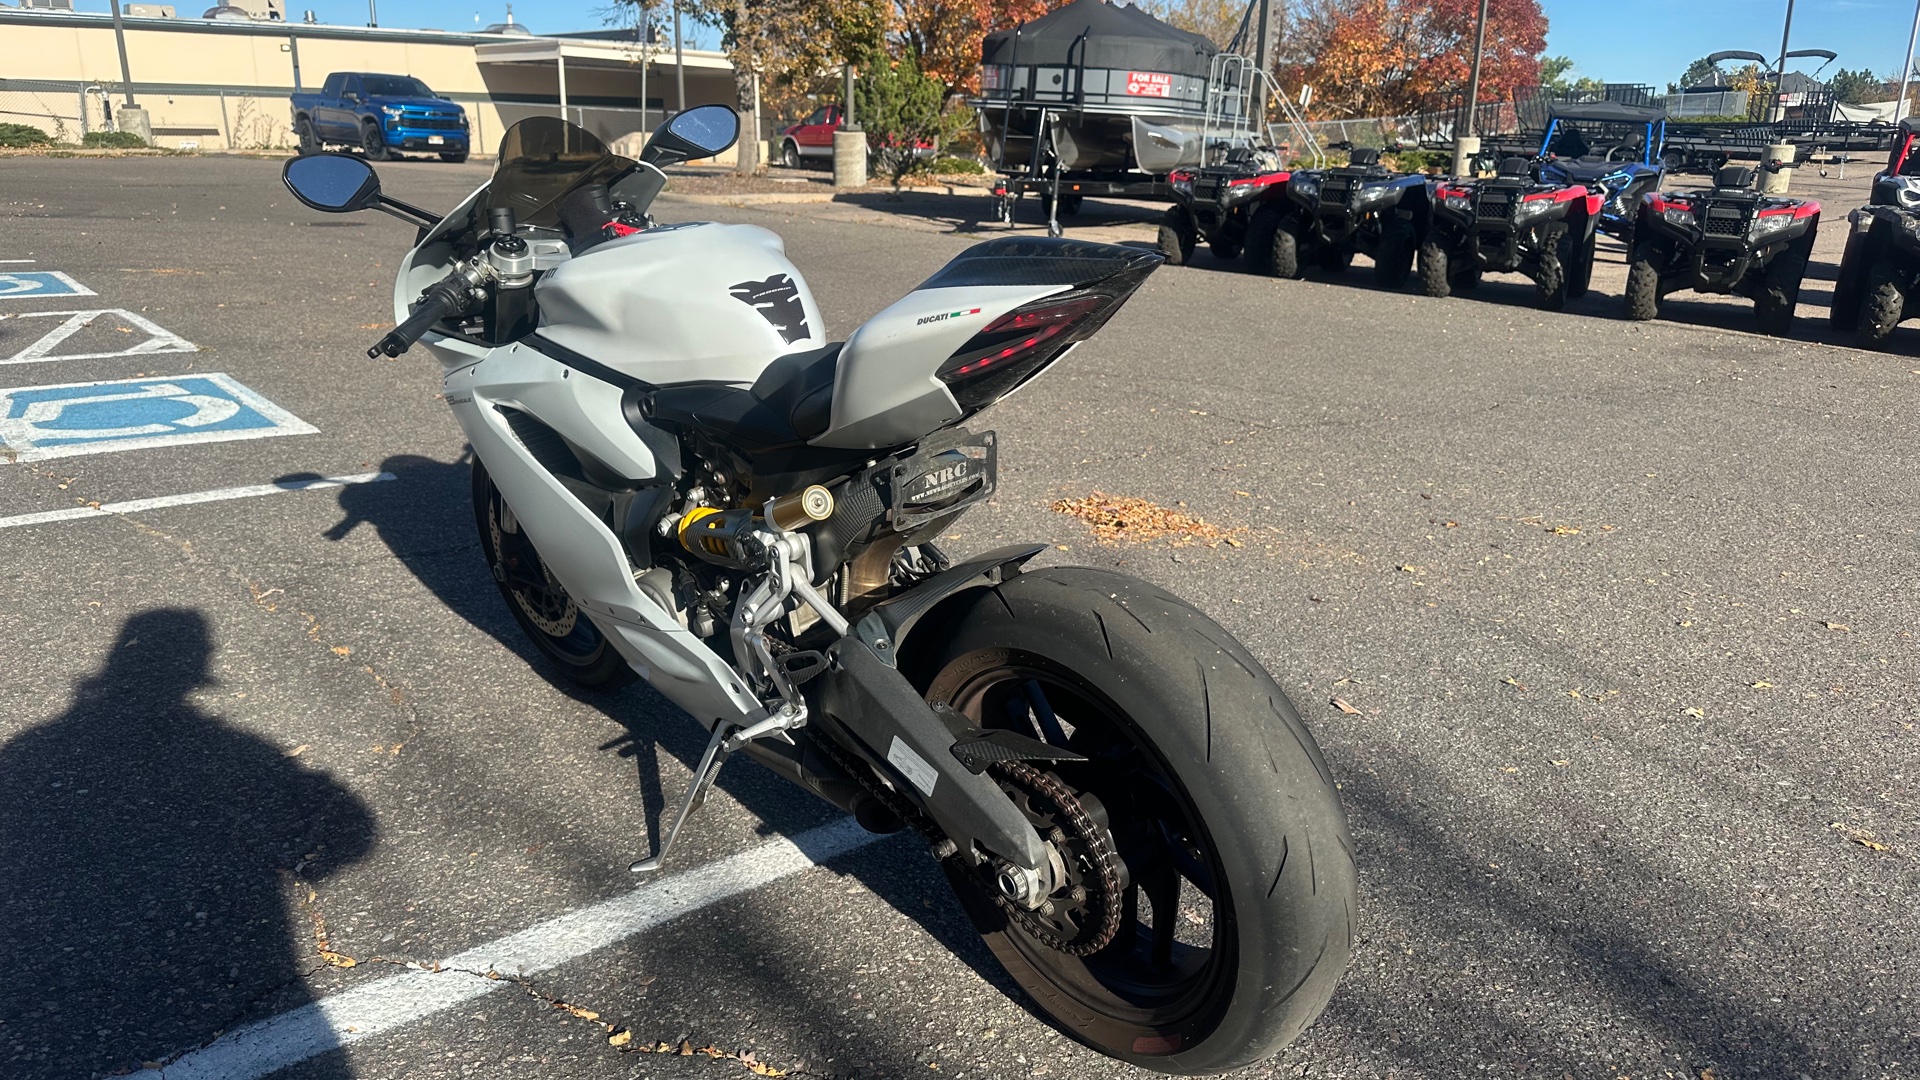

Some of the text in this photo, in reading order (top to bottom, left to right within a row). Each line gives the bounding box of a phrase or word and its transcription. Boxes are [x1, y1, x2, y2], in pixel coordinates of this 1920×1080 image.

[1132, 73, 1169, 84] FOR SALE
[916, 312, 949, 326] DUCATI
[924, 461, 967, 489] NRC
